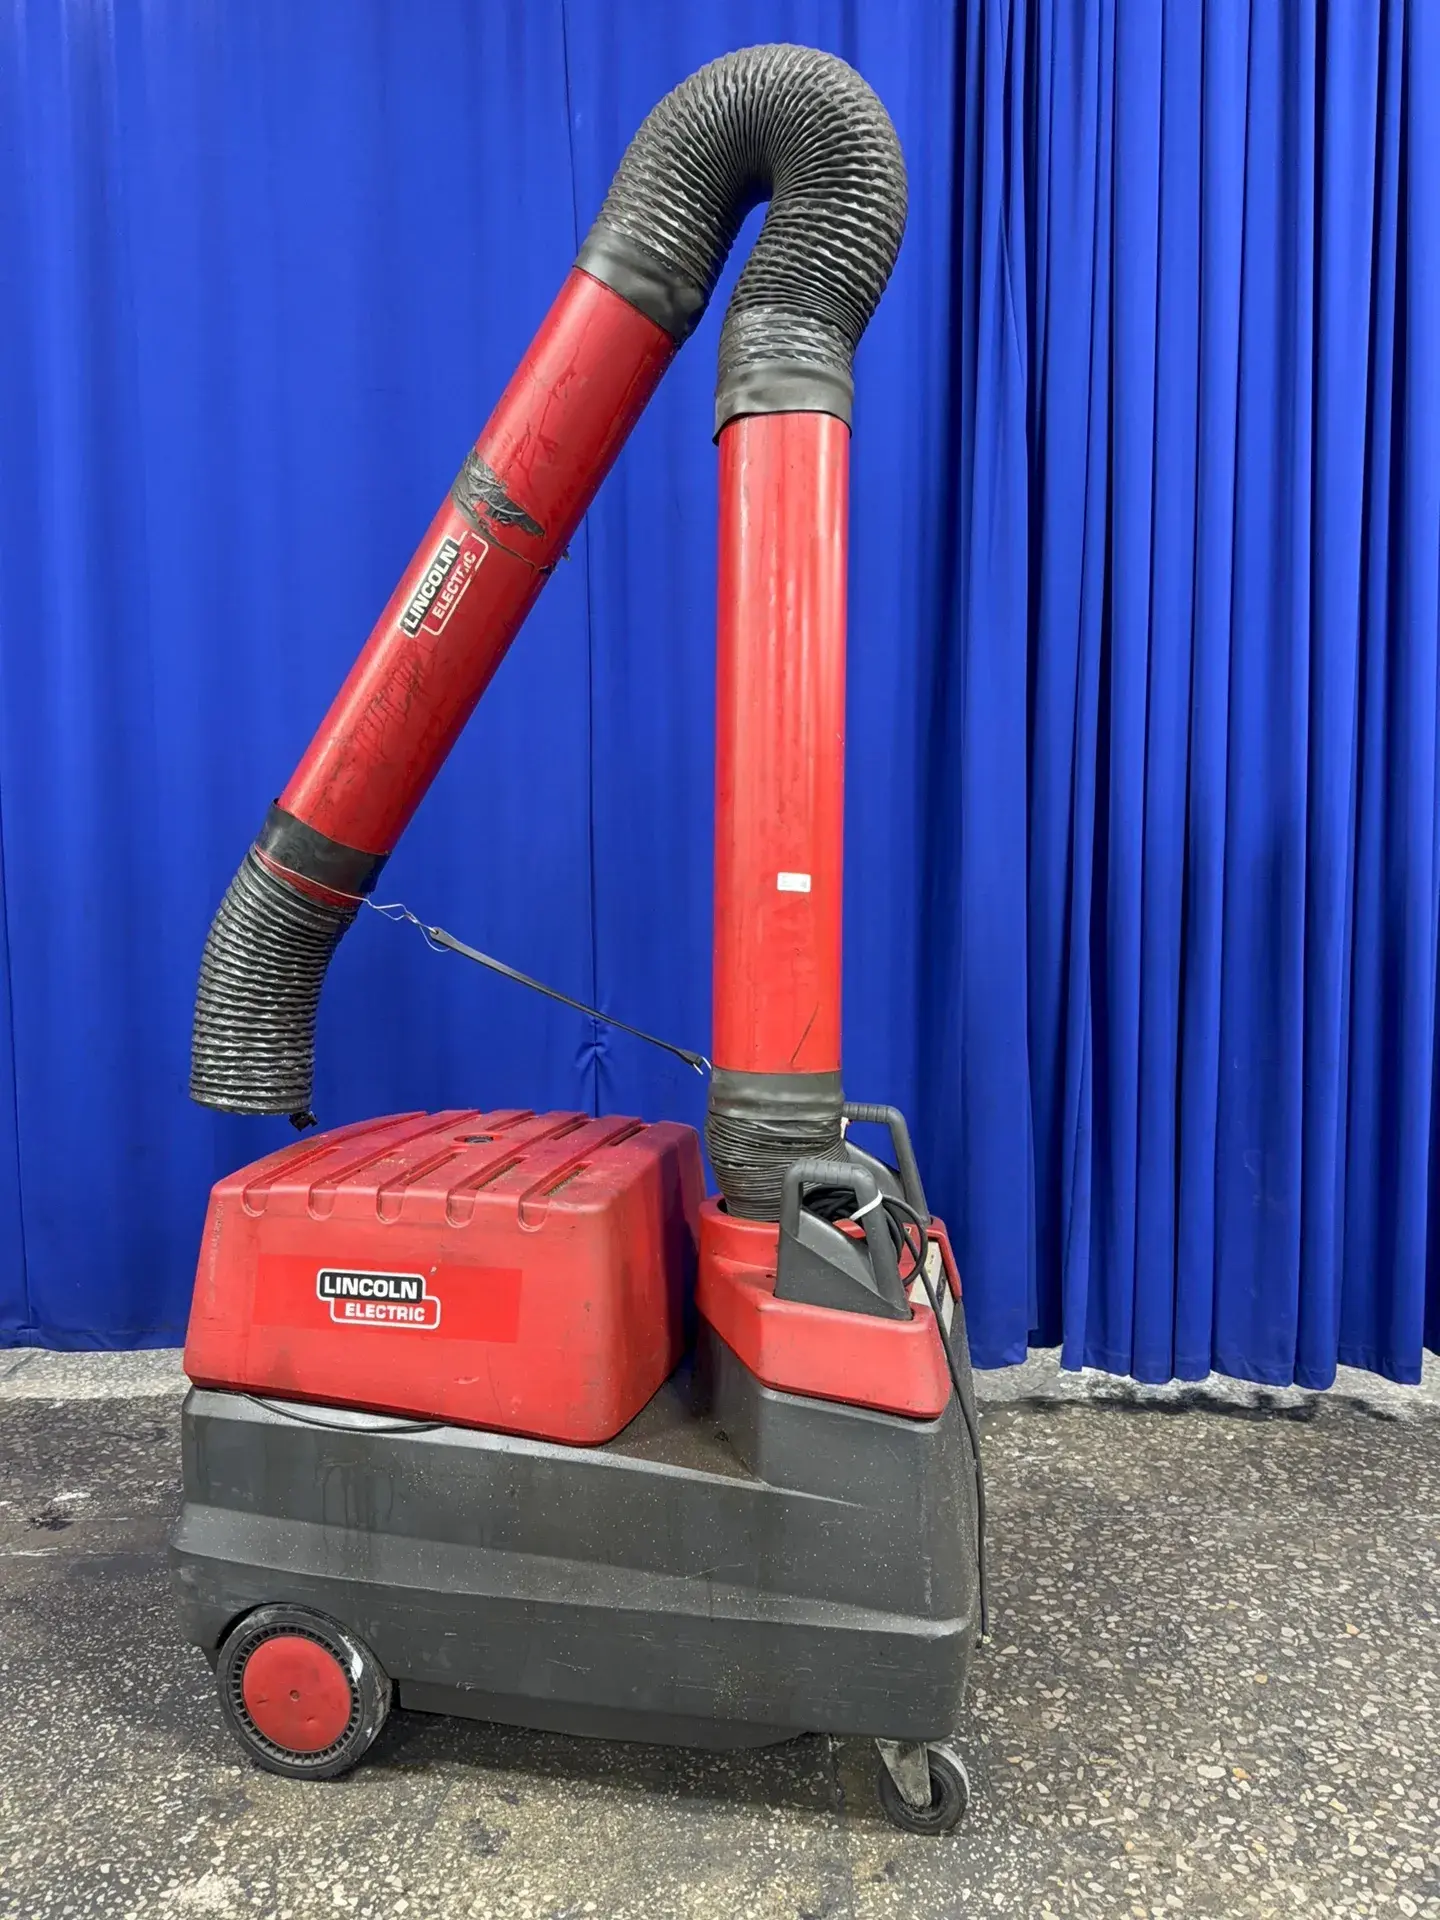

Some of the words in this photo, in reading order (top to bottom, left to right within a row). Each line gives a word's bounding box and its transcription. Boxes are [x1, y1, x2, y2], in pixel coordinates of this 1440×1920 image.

[404, 544, 458, 629] LINCOLN
[324, 1276, 418, 1299] LINCOLN
[345, 1302, 426, 1321] ELECTRIC
